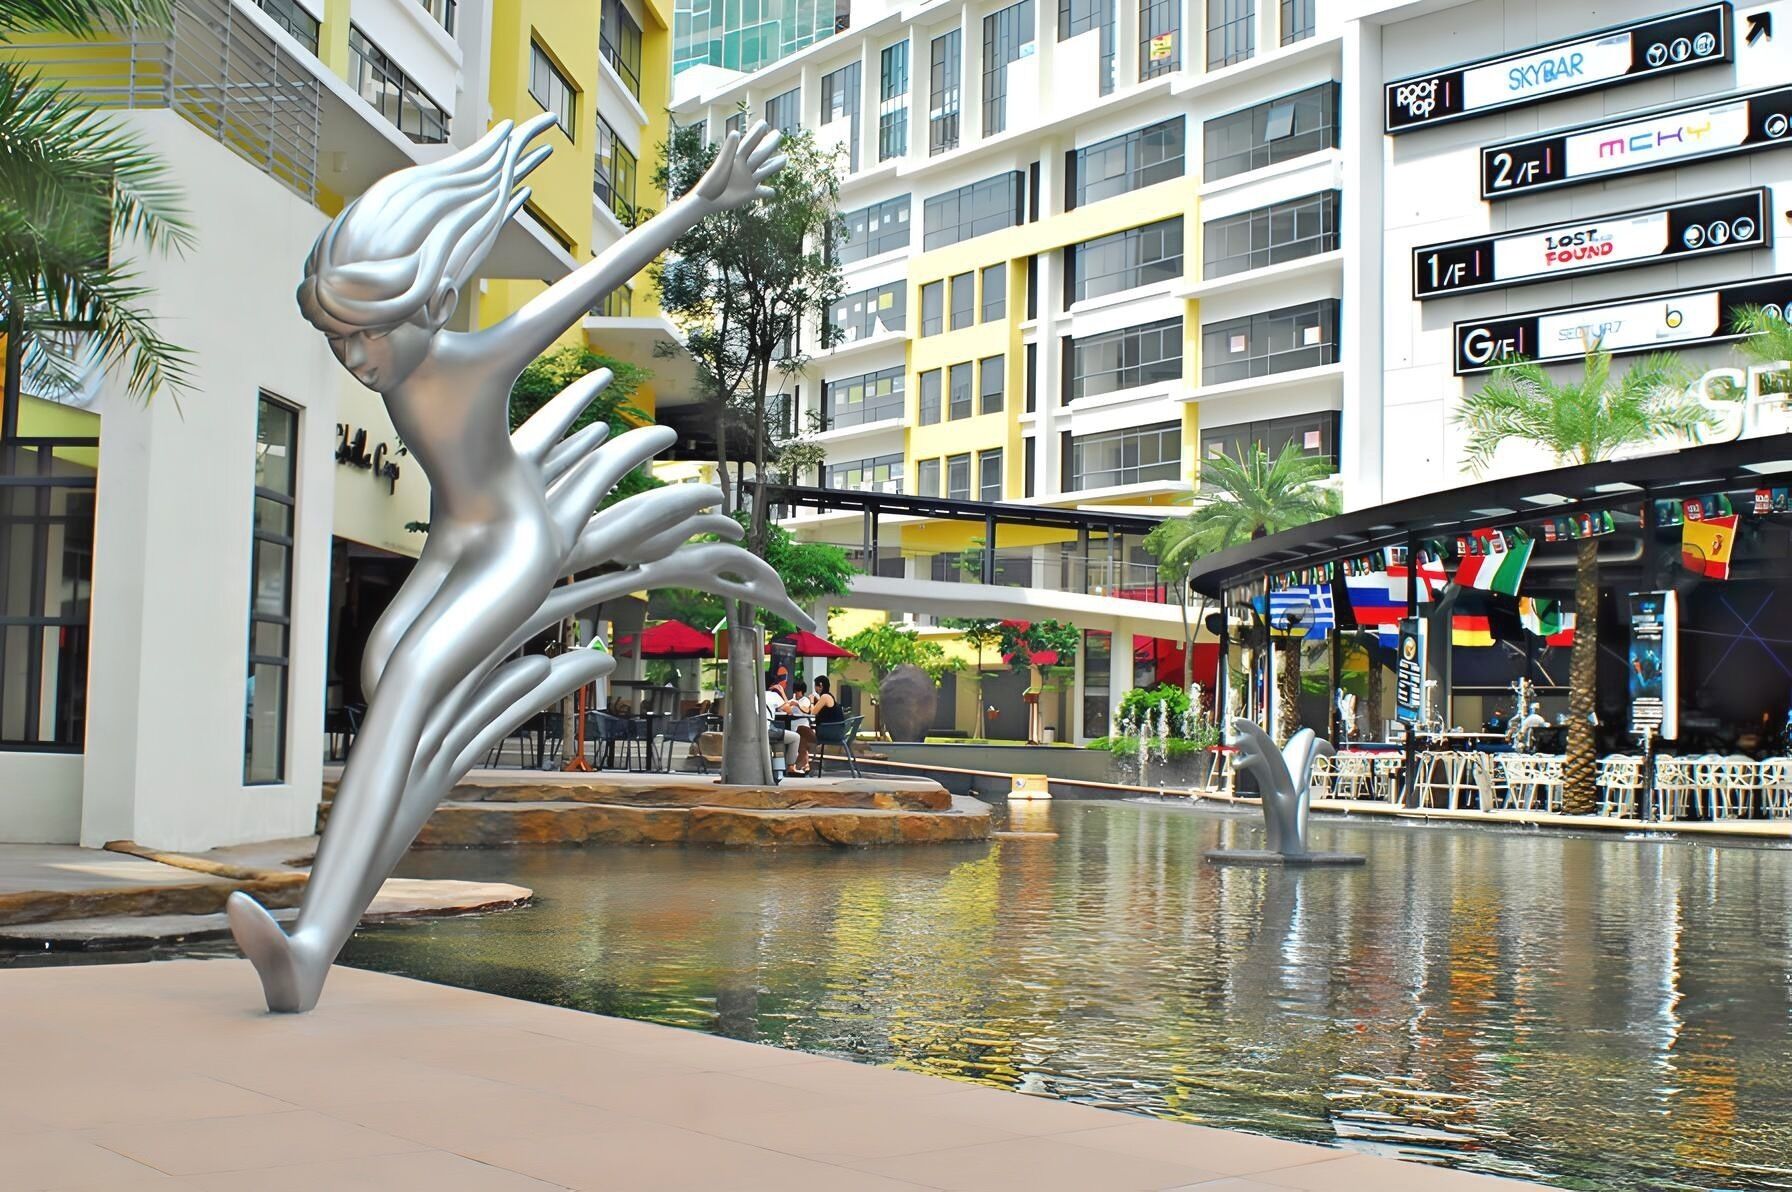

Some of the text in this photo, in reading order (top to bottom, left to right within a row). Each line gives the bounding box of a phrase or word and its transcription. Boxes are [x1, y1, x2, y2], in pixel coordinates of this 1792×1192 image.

[1508, 52, 1584, 91] SKYBAR
[1397, 79, 1439, 107] ROOF
[1493, 152, 1540, 188] 2/F
[1545, 229, 1598, 250] LOST
[1545, 242, 1613, 266] FOUND
[1427, 253, 1466, 288] 1/F
[1464, 328, 1515, 363] G/F
